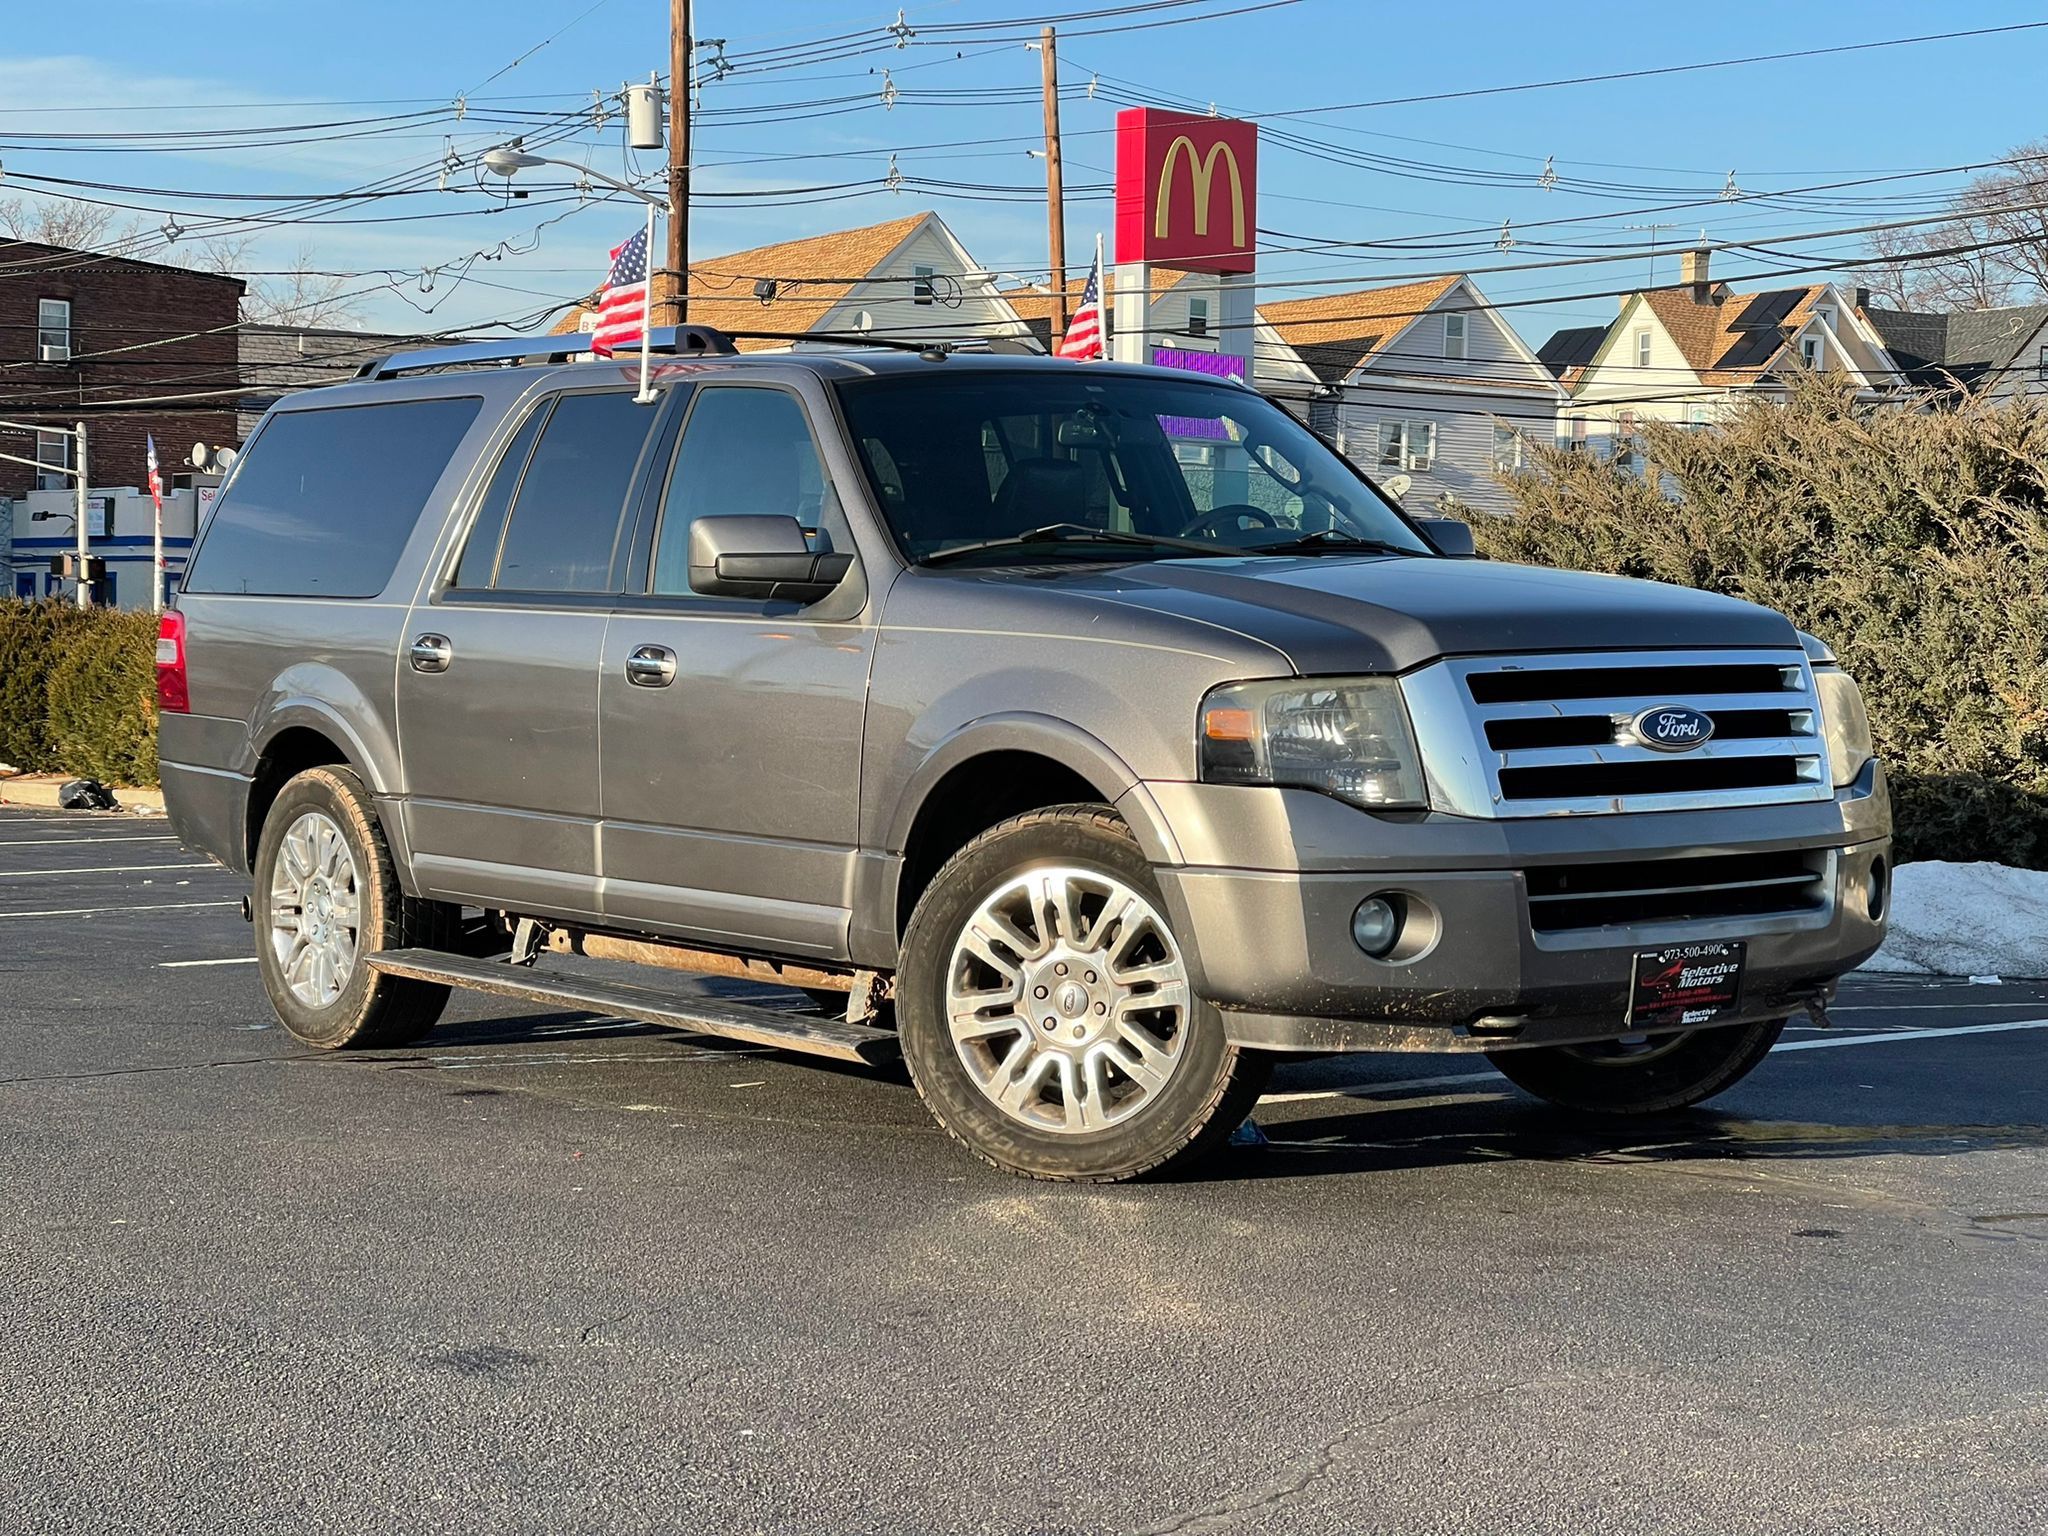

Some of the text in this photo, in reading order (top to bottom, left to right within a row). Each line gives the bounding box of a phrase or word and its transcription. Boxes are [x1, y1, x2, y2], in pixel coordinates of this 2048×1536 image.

[1657, 713, 1700, 737] Ford
[1681, 963, 1738, 977] Selective
[1677, 975, 1725, 988] Motors
